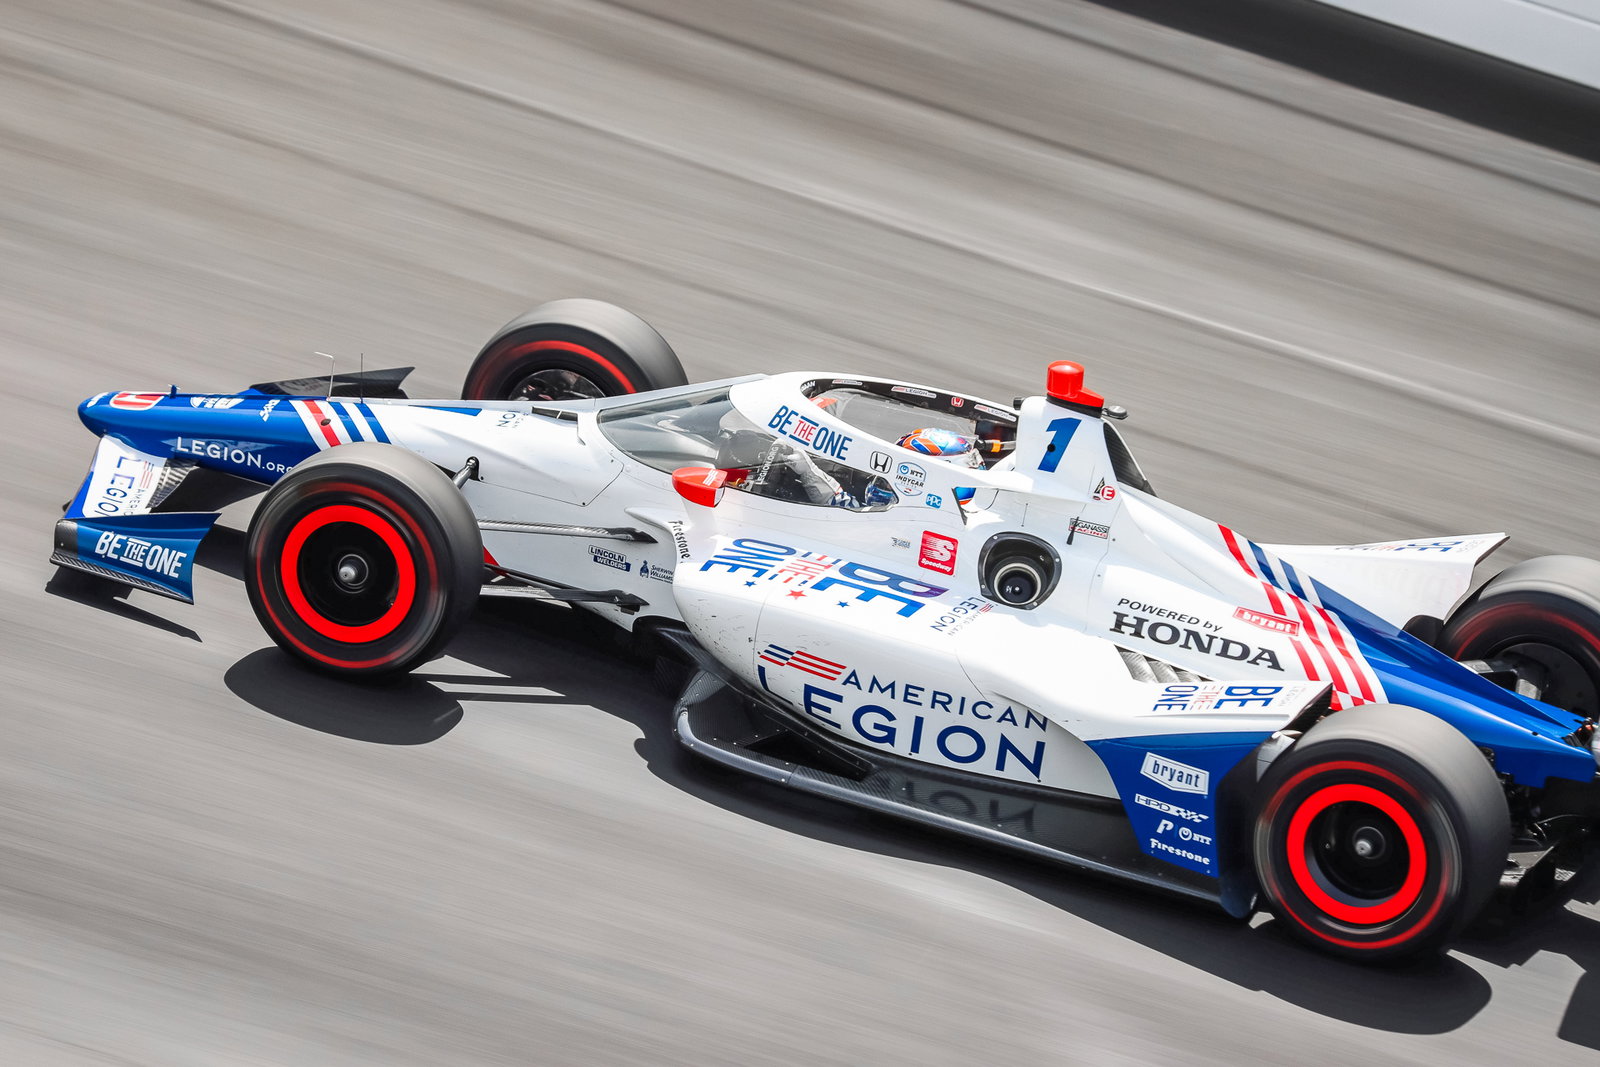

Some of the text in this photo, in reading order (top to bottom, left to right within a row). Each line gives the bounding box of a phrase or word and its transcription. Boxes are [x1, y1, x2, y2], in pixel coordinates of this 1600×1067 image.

[768, 405, 853, 461] BE THE ONE
[1037, 417, 1082, 473] 1
[896, 475, 925, 487] INDYCAR
[910, 469, 924, 478] NTT
[927, 495, 941, 507] PPG
[1102, 486, 1114, 500] E
[668, 520, 691, 559] Firestone
[94, 530, 187, 578] BE THE ONE
[590, 546, 625, 563] LINCOLN
[596, 556, 627, 570] WELDERS
[699, 538, 797, 578] ONE
[920, 557, 952, 573] Speedway
[778, 559, 834, 580] THE
[810, 561, 949, 618] BE
[930, 597, 986, 632] LEGION
[1117, 598, 1223, 632] POWERED by
[1242, 611, 1292, 633] bryant
[1109, 611, 1285, 672] HONDA
[842, 669, 1048, 733] AMERICAN
[1152, 685, 1199, 711] ONE
[1213, 686, 1284, 709] BE
[758, 665, 1046, 780] LEGION
[1152, 760, 1200, 788] bryant
[1136, 795, 1171, 812] HPD
[1149, 838, 1210, 865] Firestone
